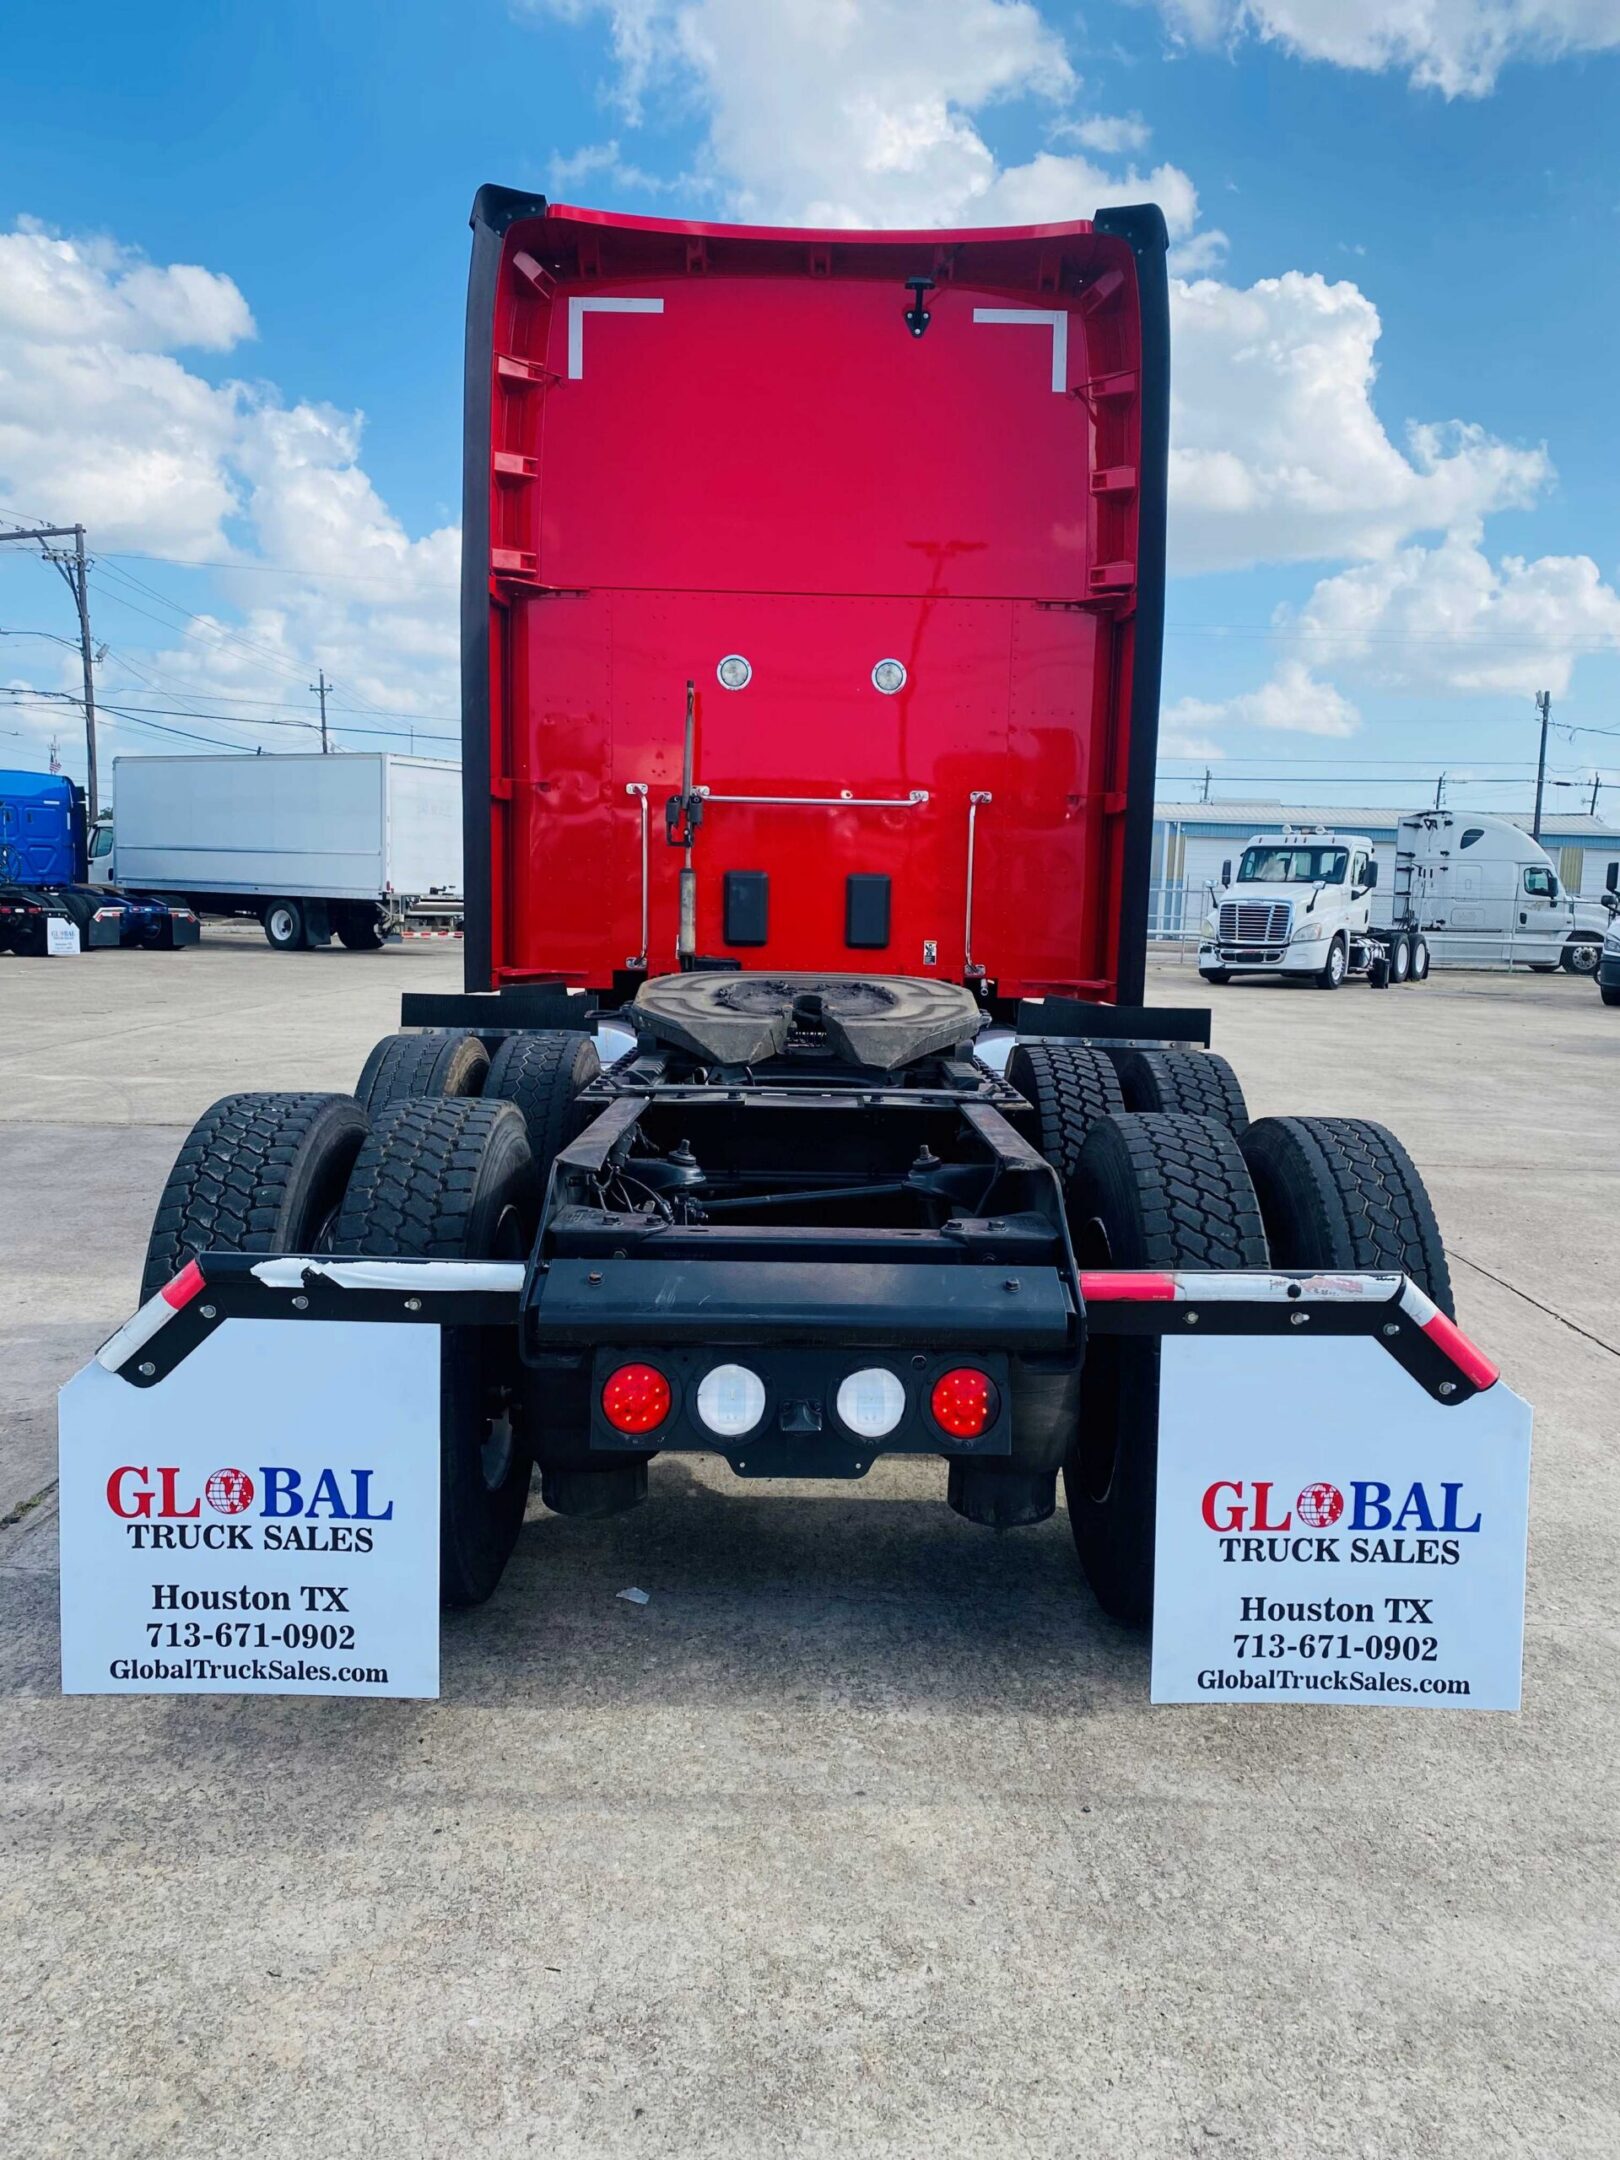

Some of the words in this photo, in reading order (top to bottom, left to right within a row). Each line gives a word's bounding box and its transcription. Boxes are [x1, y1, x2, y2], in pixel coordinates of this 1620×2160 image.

[127, 1524, 253, 1549] TRUCK
[264, 1525, 373, 1553] SALES
[1219, 1538, 1340, 1562] TRUCK
[1351, 1538, 1459, 1565] SALES
[152, 1585, 291, 1610] Houston
[300, 1586, 349, 1612] TX
[1240, 1597, 1374, 1622] Houston
[1385, 1598, 1433, 1624] TX
[147, 1623, 354, 1650] 713-671-0902
[1234, 1634, 1437, 1661] 713-671-0902
[110, 1659, 388, 1683] GlobalTruckSales.com
[1198, 1670, 1470, 1694] GlobalTruckSales.com
